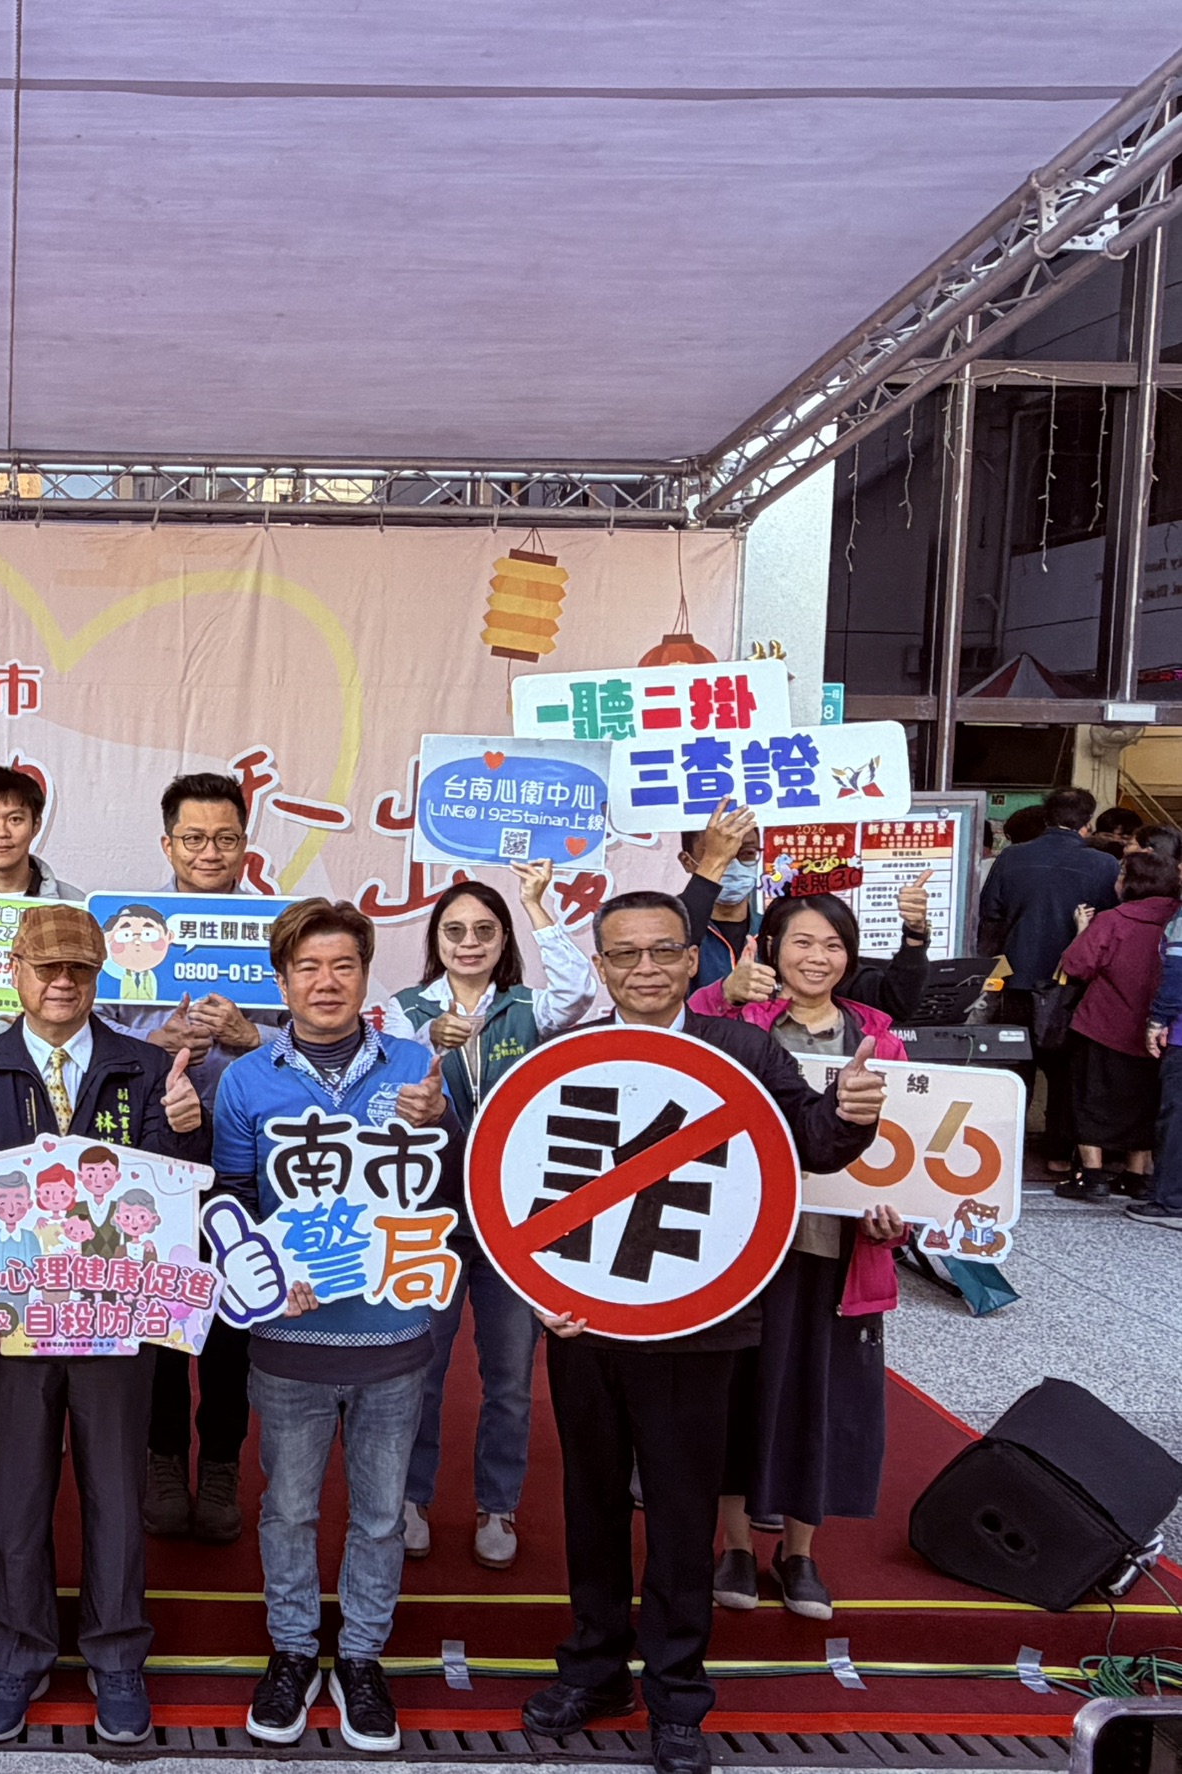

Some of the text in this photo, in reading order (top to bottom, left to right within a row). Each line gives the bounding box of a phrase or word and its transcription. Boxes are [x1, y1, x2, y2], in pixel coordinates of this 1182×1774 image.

[536, 674, 757, 741] 一聽二掛
[443, 774, 596, 810] 台南心衛中心
[630, 733, 820, 815] 三查證
[429, 802, 605, 831] LINE@1925tainan上線
[794, 825, 826, 835] 2026
[174, 962, 277, 983] 0800-013-
[271, 1112, 440, 1209] 南市
[526, 1084, 729, 1283] 詐
[277, 1196, 457, 1304] 警局
[23, 1301, 170, 1338] 自殺防治
